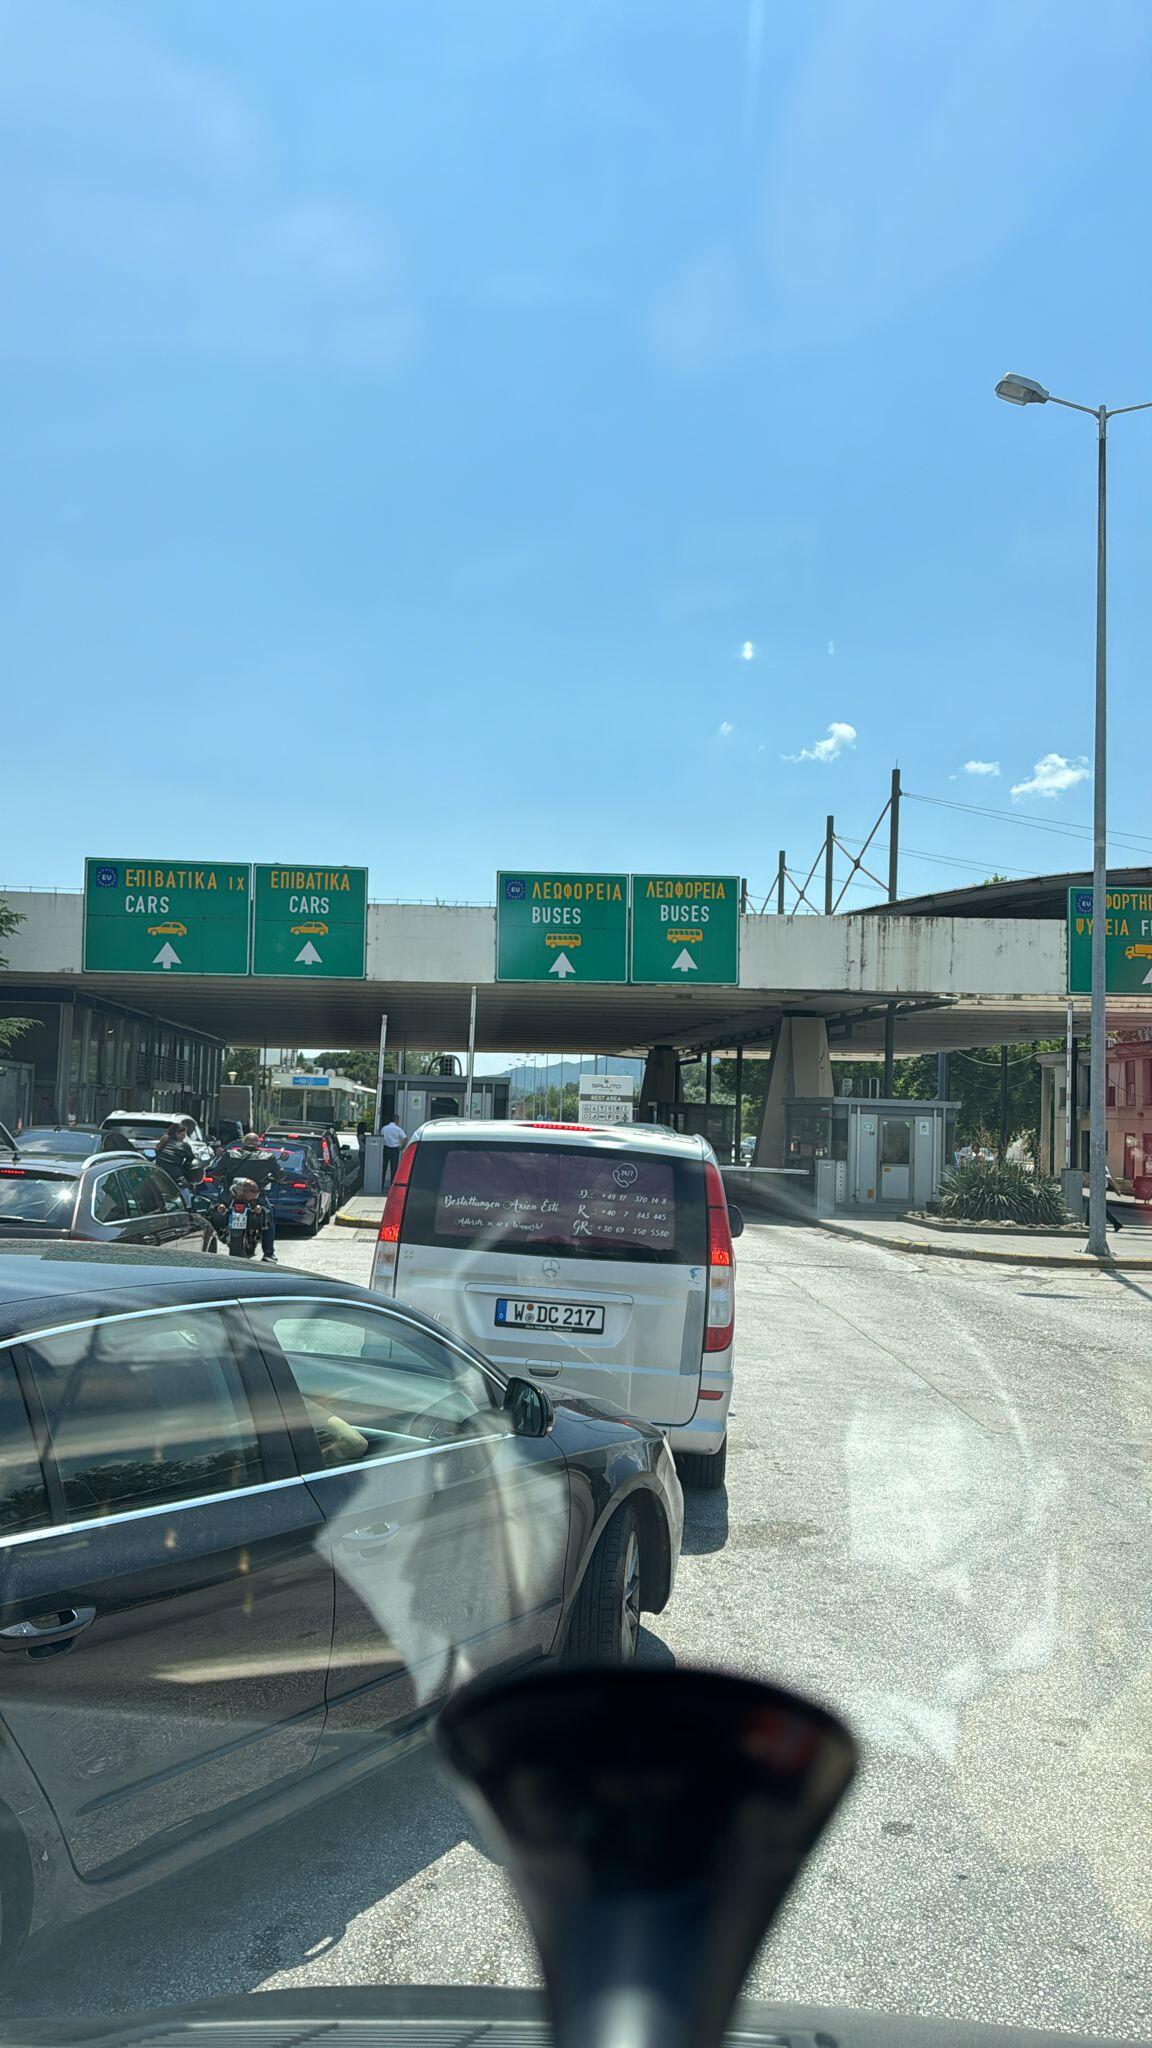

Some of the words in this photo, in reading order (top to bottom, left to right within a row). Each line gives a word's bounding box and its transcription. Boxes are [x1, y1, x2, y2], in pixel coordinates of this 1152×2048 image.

[101, 873, 112, 881] EU
[124, 868, 218, 890] ΕΠΙΒΑΤΙΚΑ
[270, 871, 351, 891] ΕΠΙΒΑΤΙΚΑ
[511, 885, 521, 893] EU
[532, 881, 622, 901] ΛΕΩΦΟΡΕΙΑ
[646, 880, 726, 899] ΛΕΩΦΟΡΕΙΑ
[125, 895, 170, 914] CARS
[289, 896, 329, 914] CARS
[660, 905, 710, 922] BUSES
[532, 907, 582, 925] BUSES
[1076, 918, 1129, 936] ΨΥΕΙΑ
[444, 1194, 500, 1211] Bestattungen
[514, 1304, 525, 1321] W
[536, 1306, 559, 1323] DC
[562, 1307, 596, 1327] 217
